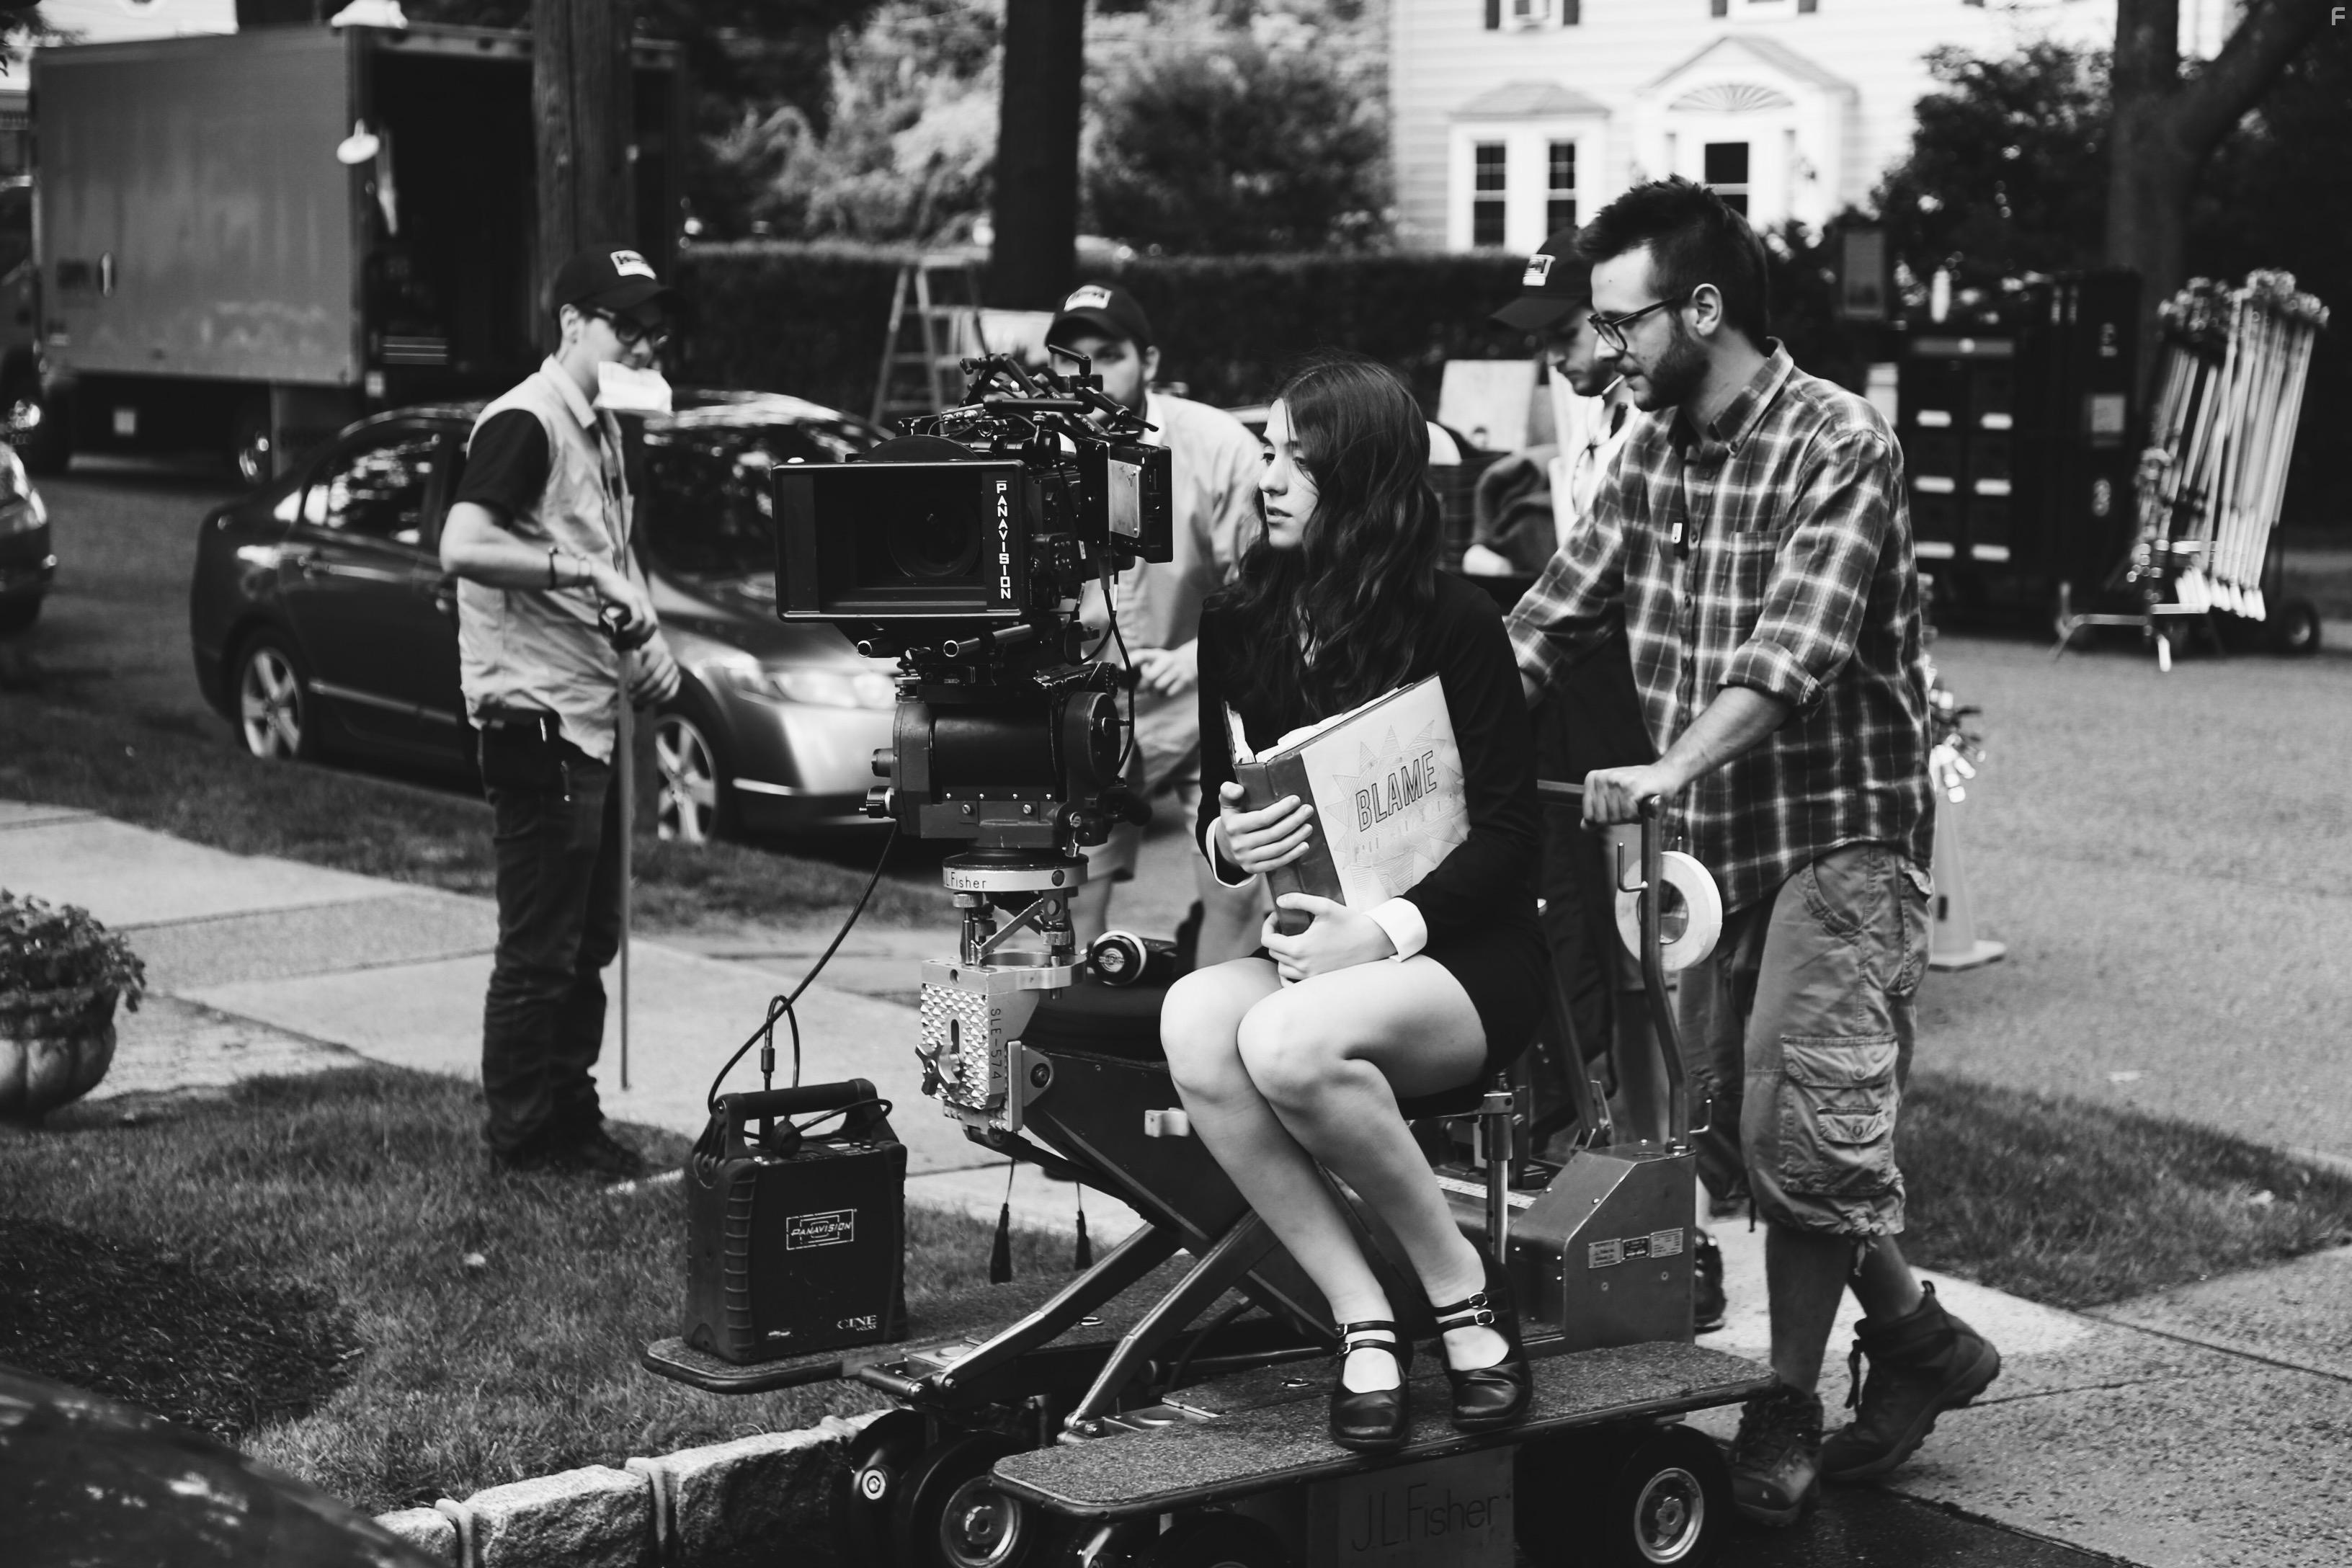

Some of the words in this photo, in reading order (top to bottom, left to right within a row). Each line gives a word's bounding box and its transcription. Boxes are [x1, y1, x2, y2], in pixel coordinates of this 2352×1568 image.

[996, 480, 1011, 600] PANAVISION
[1355, 750, 1437, 832] BLAME
[990, 1008, 1002, 1079] SLE-574
[790, 1222, 852, 1236] PANAVISION
[836, 1314, 877, 1329] CINE
